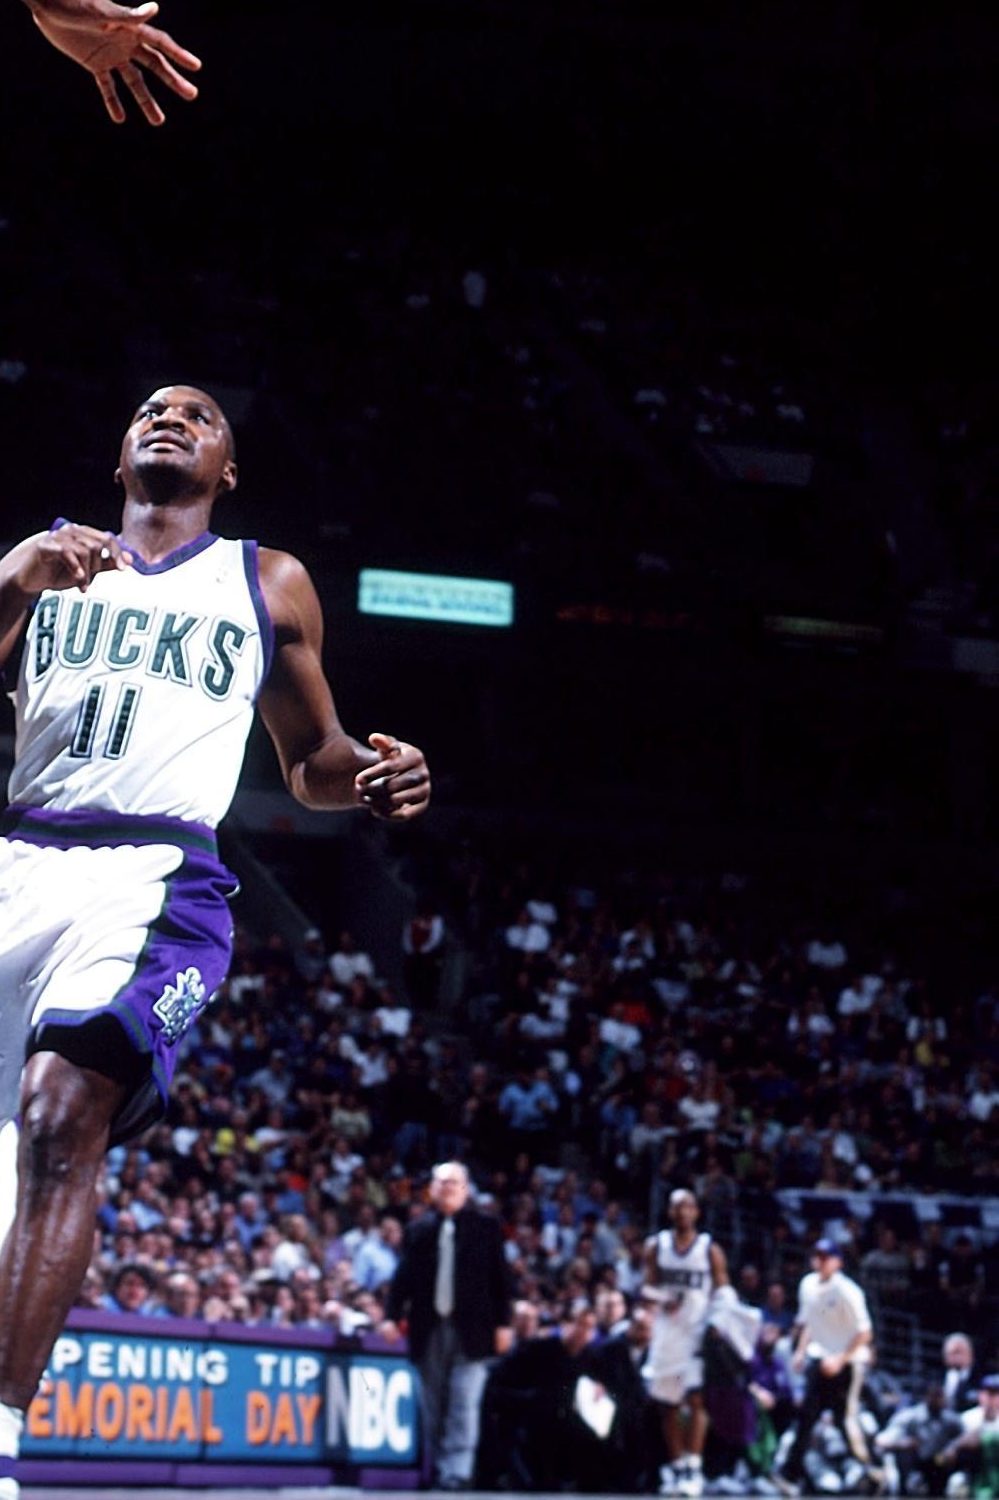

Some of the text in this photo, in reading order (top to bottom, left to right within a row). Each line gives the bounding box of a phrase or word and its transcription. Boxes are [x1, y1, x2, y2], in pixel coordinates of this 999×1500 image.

[32, 592, 252, 703] BUCKS
[69, 681, 143, 760] 11
[52, 1337, 322, 1388] PENING TIP
[27, 1380, 322, 1446] EMORIAL DAY
[324, 1365, 413, 1454] NBC
